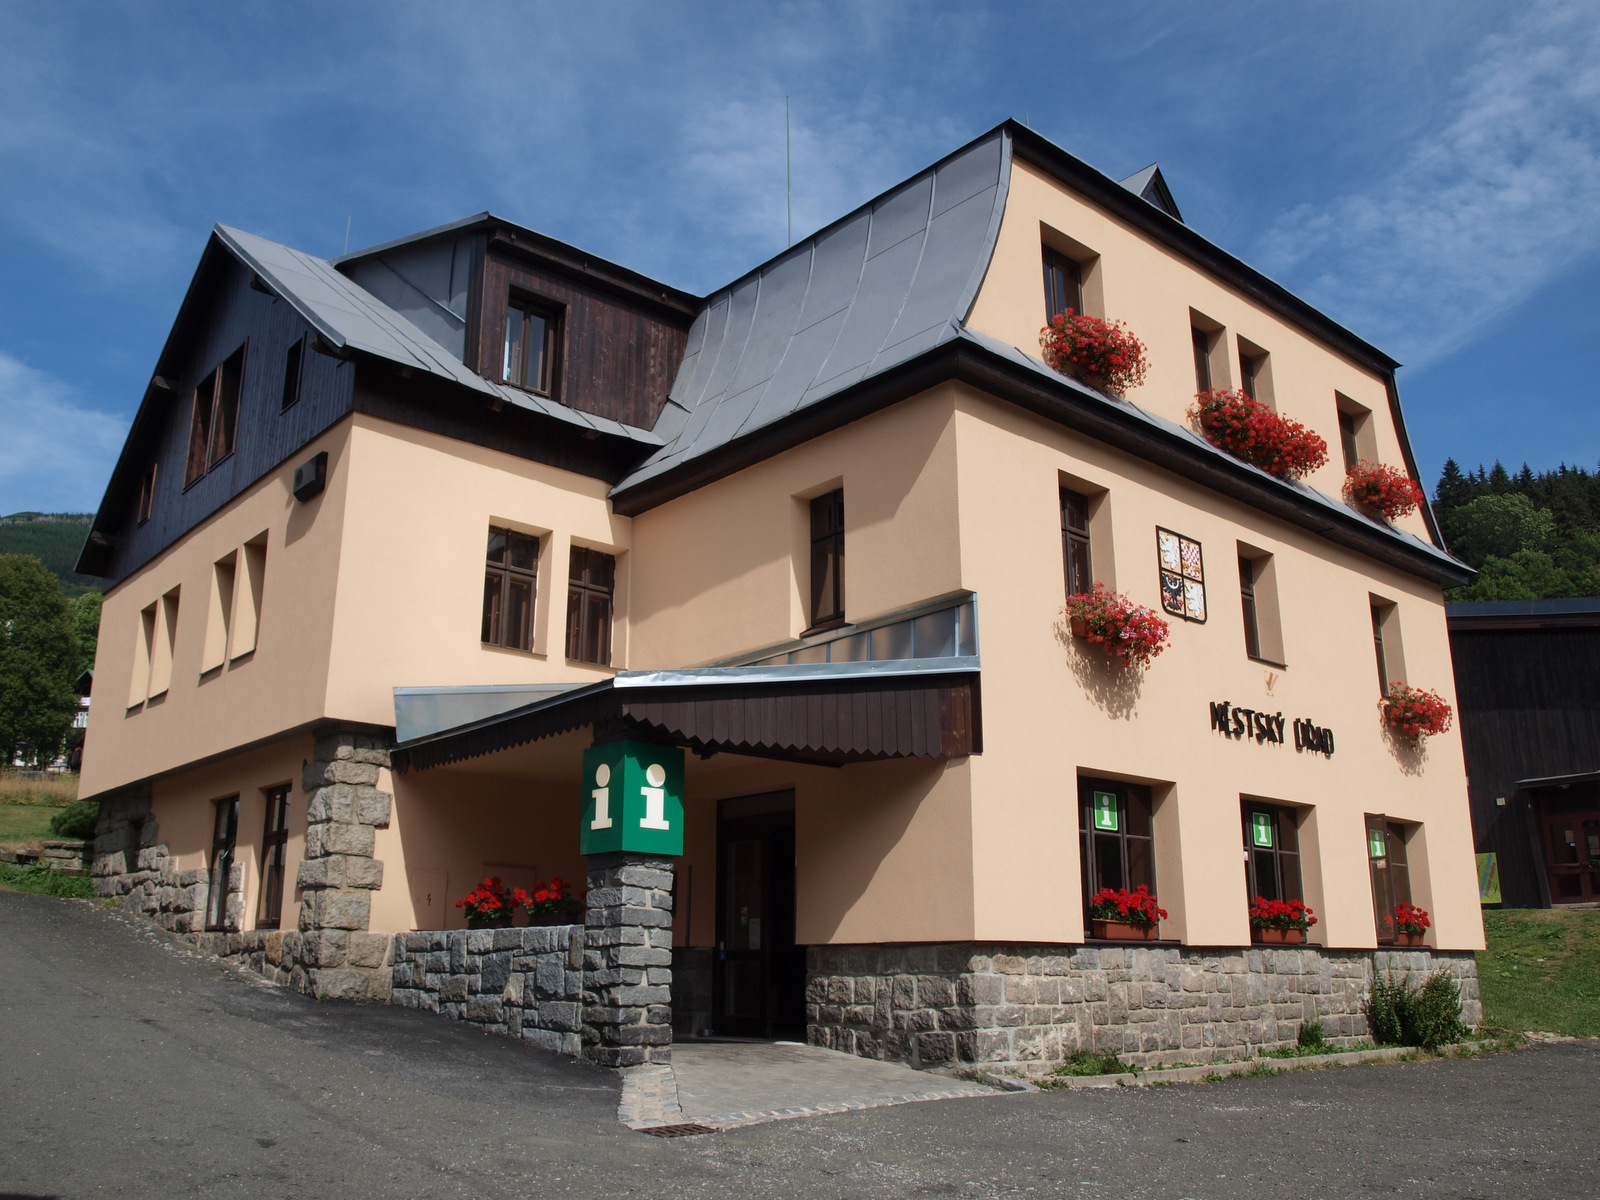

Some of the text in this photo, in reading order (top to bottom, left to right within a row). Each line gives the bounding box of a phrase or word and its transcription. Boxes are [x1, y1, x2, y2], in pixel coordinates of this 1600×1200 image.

[1210, 701, 1285, 745] MĚSTSKÝ
[591, 763, 612, 830] i
[640, 763, 669, 830] i
[1101, 795, 1112, 826] i
[1258, 816, 1268, 843] i
